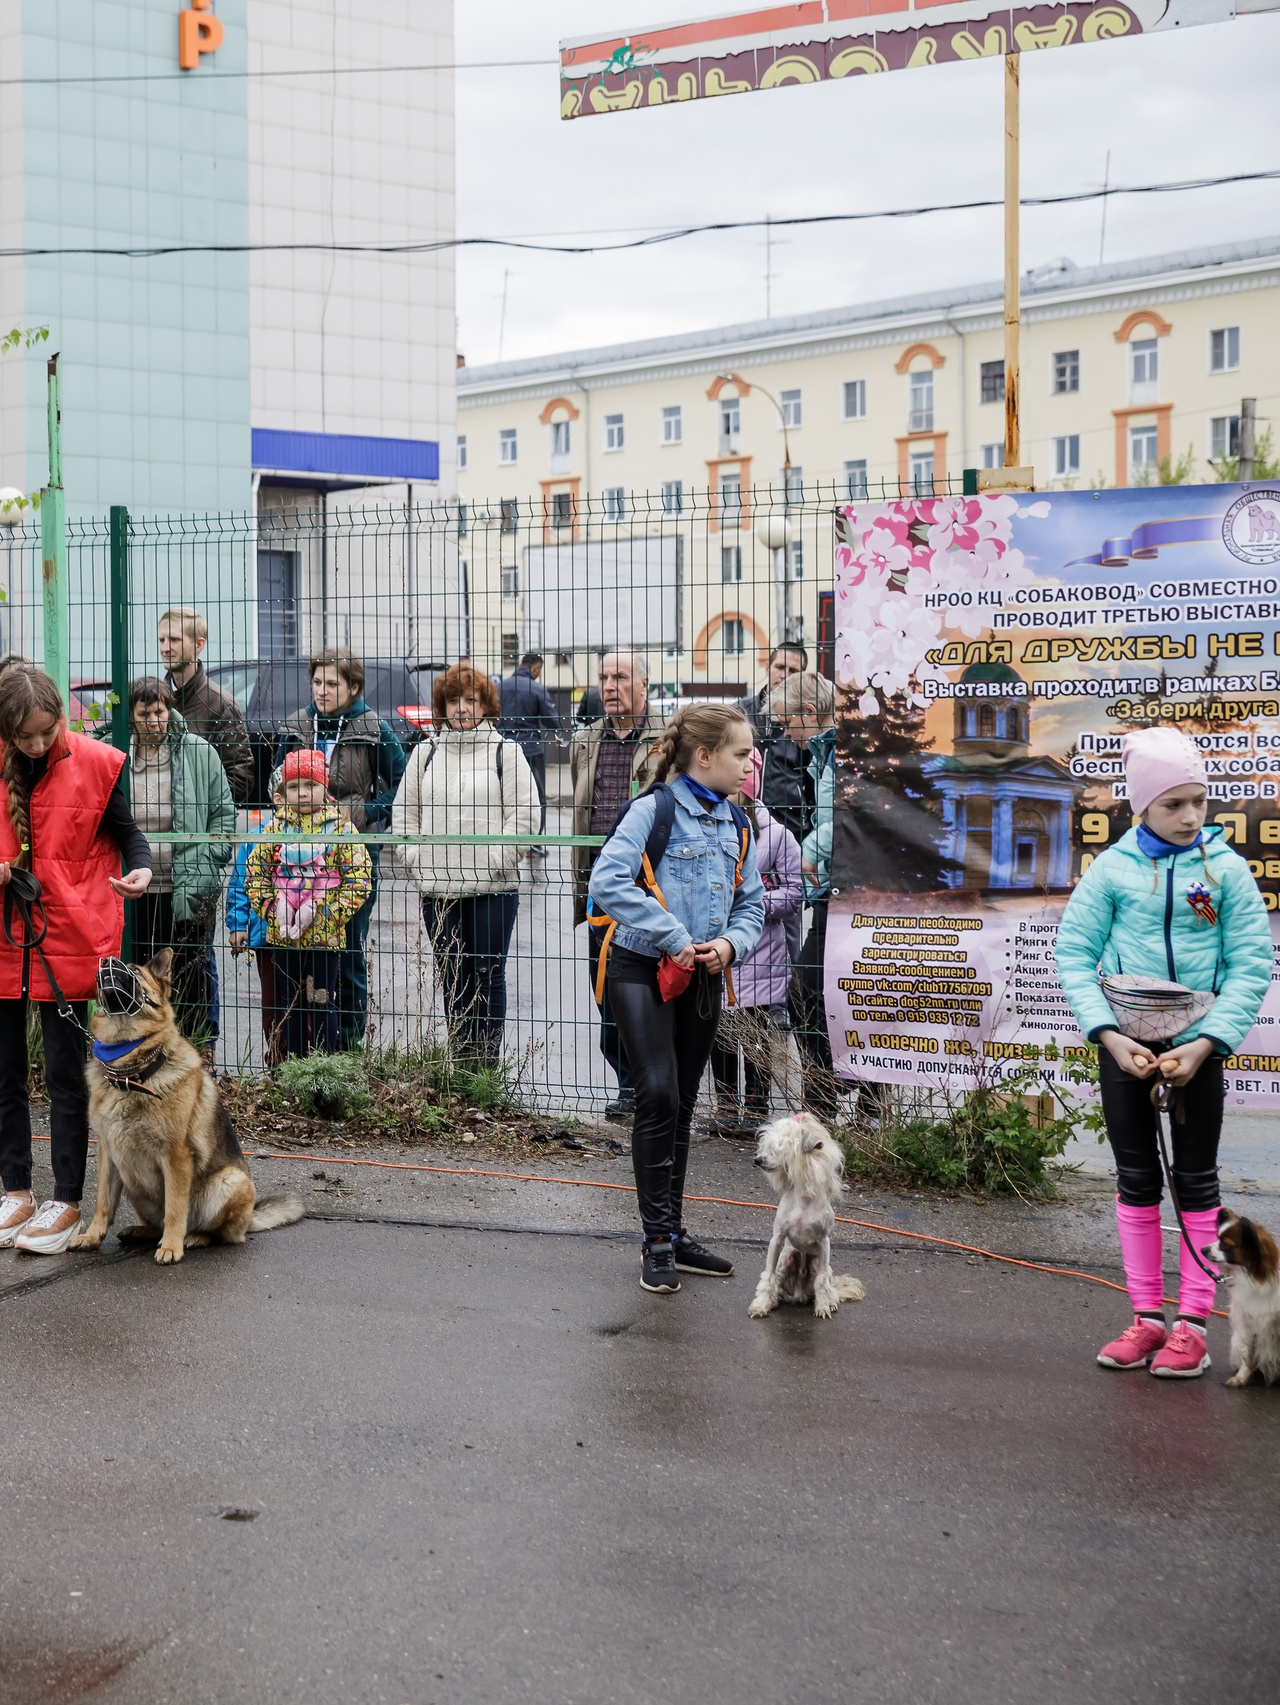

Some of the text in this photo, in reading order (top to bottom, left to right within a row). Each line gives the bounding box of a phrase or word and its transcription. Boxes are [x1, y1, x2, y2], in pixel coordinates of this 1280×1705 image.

[179, 0, 223, 70] Р
[925, 579, 1277, 608] НРОО КЦ «СОБАКОВОД» СОВМЕСТНО
[993, 610, 1097, 628] ПРОВОДИТ
[1102, 607, 1180, 624] ТРЕТЬЮ
[924, 640, 1013, 665] «ДЛЯ
[1020, 634, 1197, 664] ДРУЖБЫ
[1208, 632, 1264, 658] НЕ
[923, 679, 1028, 699] Выставка
[1032, 677, 1141, 700] проходит
[1144, 680, 1160, 694] в
[1165, 674, 1256, 697] рамках
[1107, 699, 1279, 721] «Забери друга
[1263, 784, 1276, 797] в
[1081, 812, 1110, 844] 9
[851, 913, 983, 931] Для участия необходимо
[1019, 922, 1026, 931] В
[872, 931, 959, 946] предварительно
[1015, 935, 1048, 947] Ринги
[861, 947, 967, 962] зарегистрироваться
[1015, 949, 1041, 960] Ринг
[853, 961, 976, 978] Заявкой-сообщением в
[1014, 964, 1049, 976] Акция
[838, 978, 992, 996] группе vk.com/club177567091
[848, 993, 983, 1011] На сайте: dog52nn.ru или
[853, 1009, 867, 1021] по
[869, 1010, 896, 1022] тел.:
[897, 1010, 905, 1021] 8
[907, 1011, 926, 1023] 915
[928, 1012, 948, 1024] 935
[1020, 1021, 1081, 1034] кинологов,
[845, 1029, 865, 1049] И,
[869, 1033, 938, 1054] конечно
[944, 1039, 977, 1058] же,
[850, 1054, 858, 1065] К
[861, 1055, 913, 1071] УЧАСТИЮ
[1235, 1079, 1266, 1093] ВЕТ.
